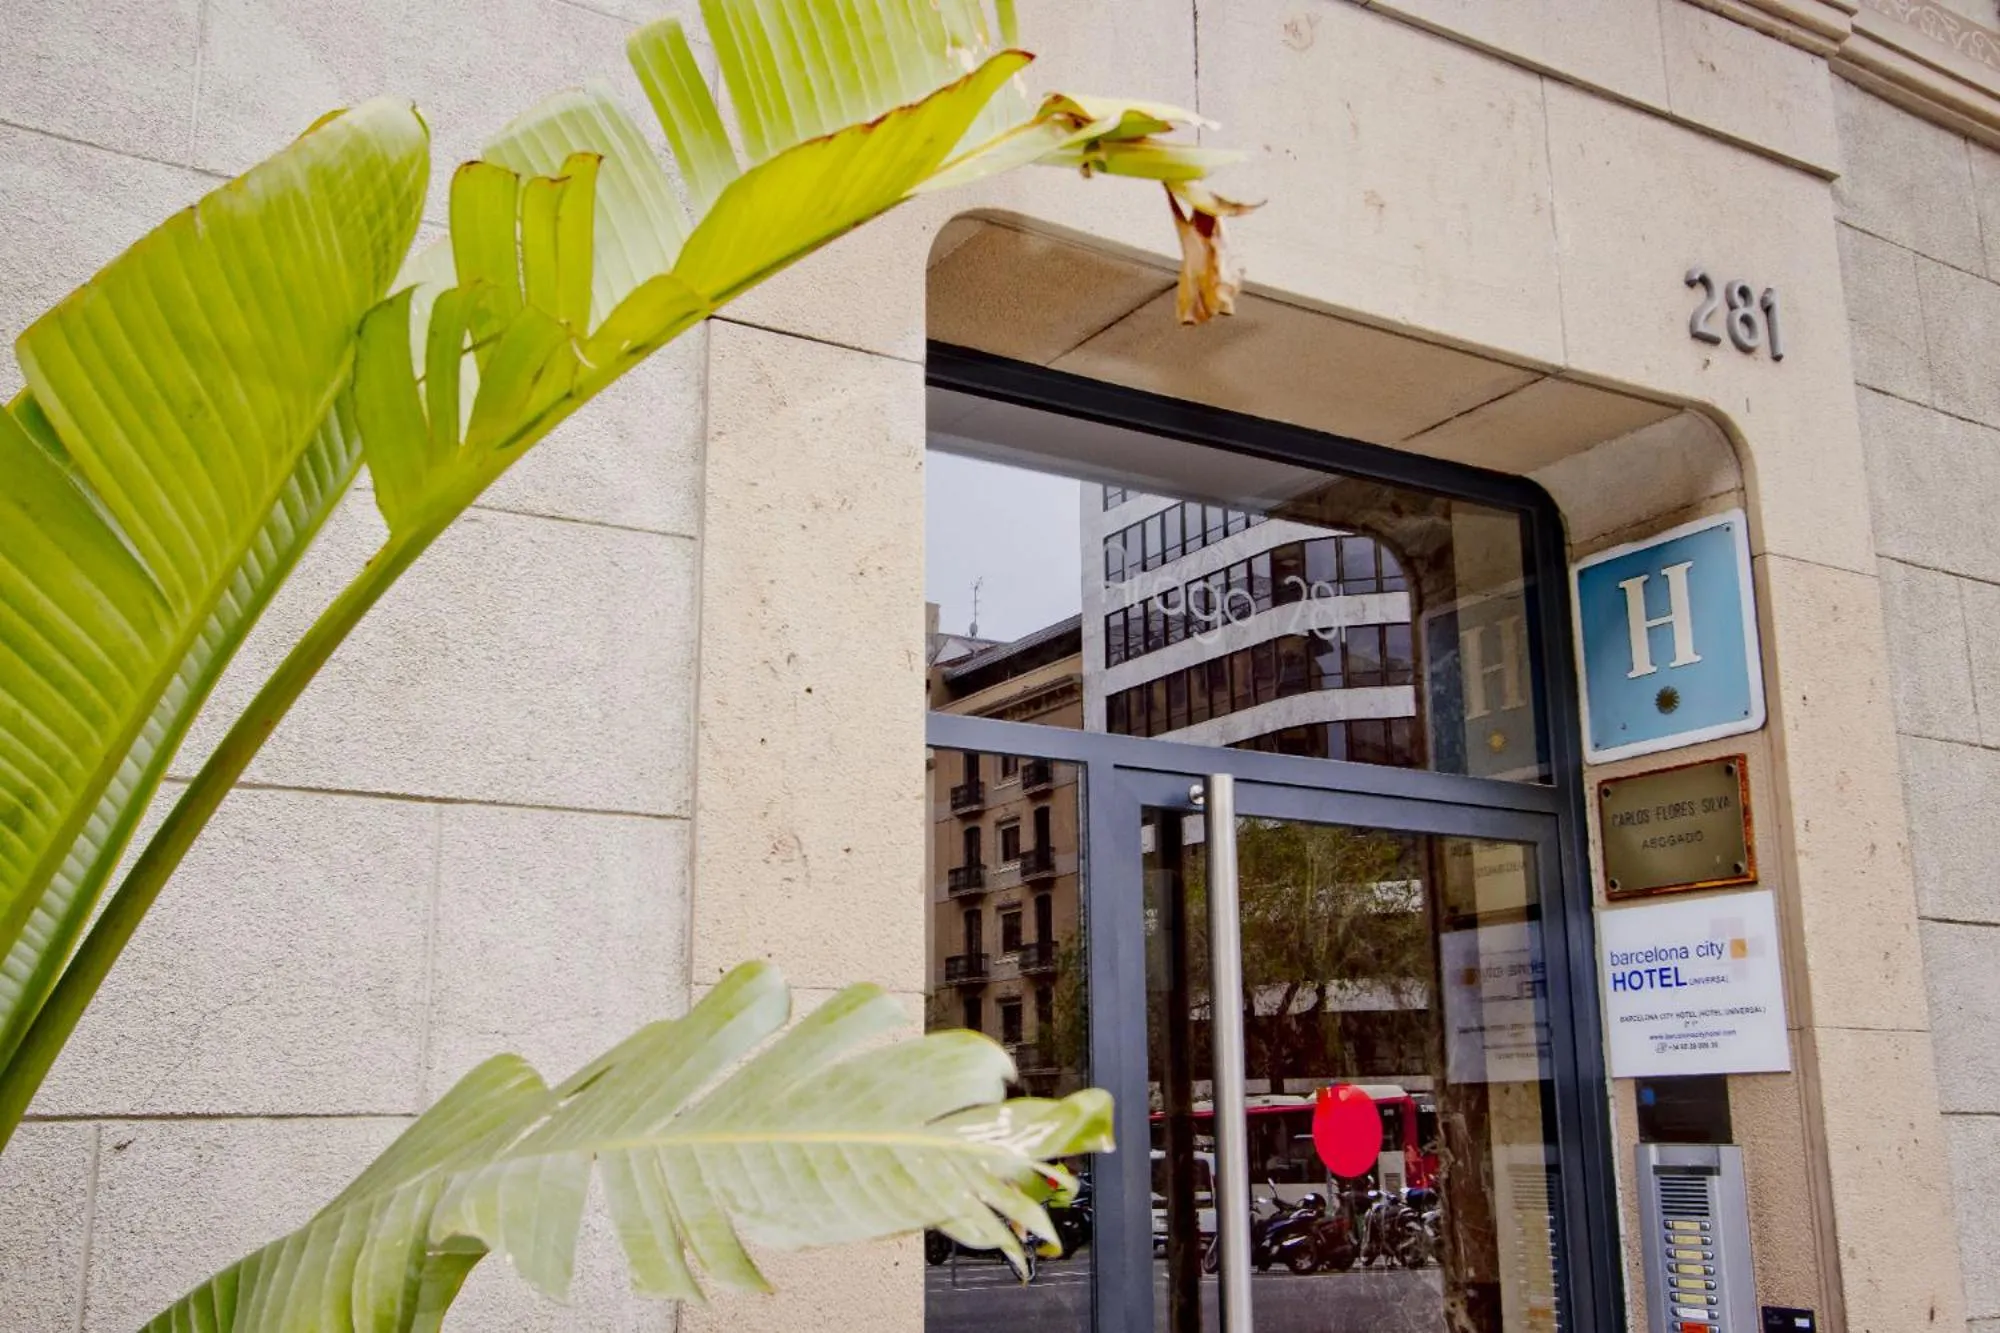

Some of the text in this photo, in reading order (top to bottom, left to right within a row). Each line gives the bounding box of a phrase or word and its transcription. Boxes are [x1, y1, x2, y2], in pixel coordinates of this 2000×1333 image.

[1684, 263, 1784, 362] 281
[1284, 575, 1347, 643] 281
[1618, 560, 1703, 679] H
[1611, 795, 1732, 828] CARLOS FLORES SILVA
[1641, 830, 1705, 850] ABOGADO
[1609, 940, 1725, 967] barcelona city
[1612, 966, 1730, 993] HOTEL UNIVERSAL
